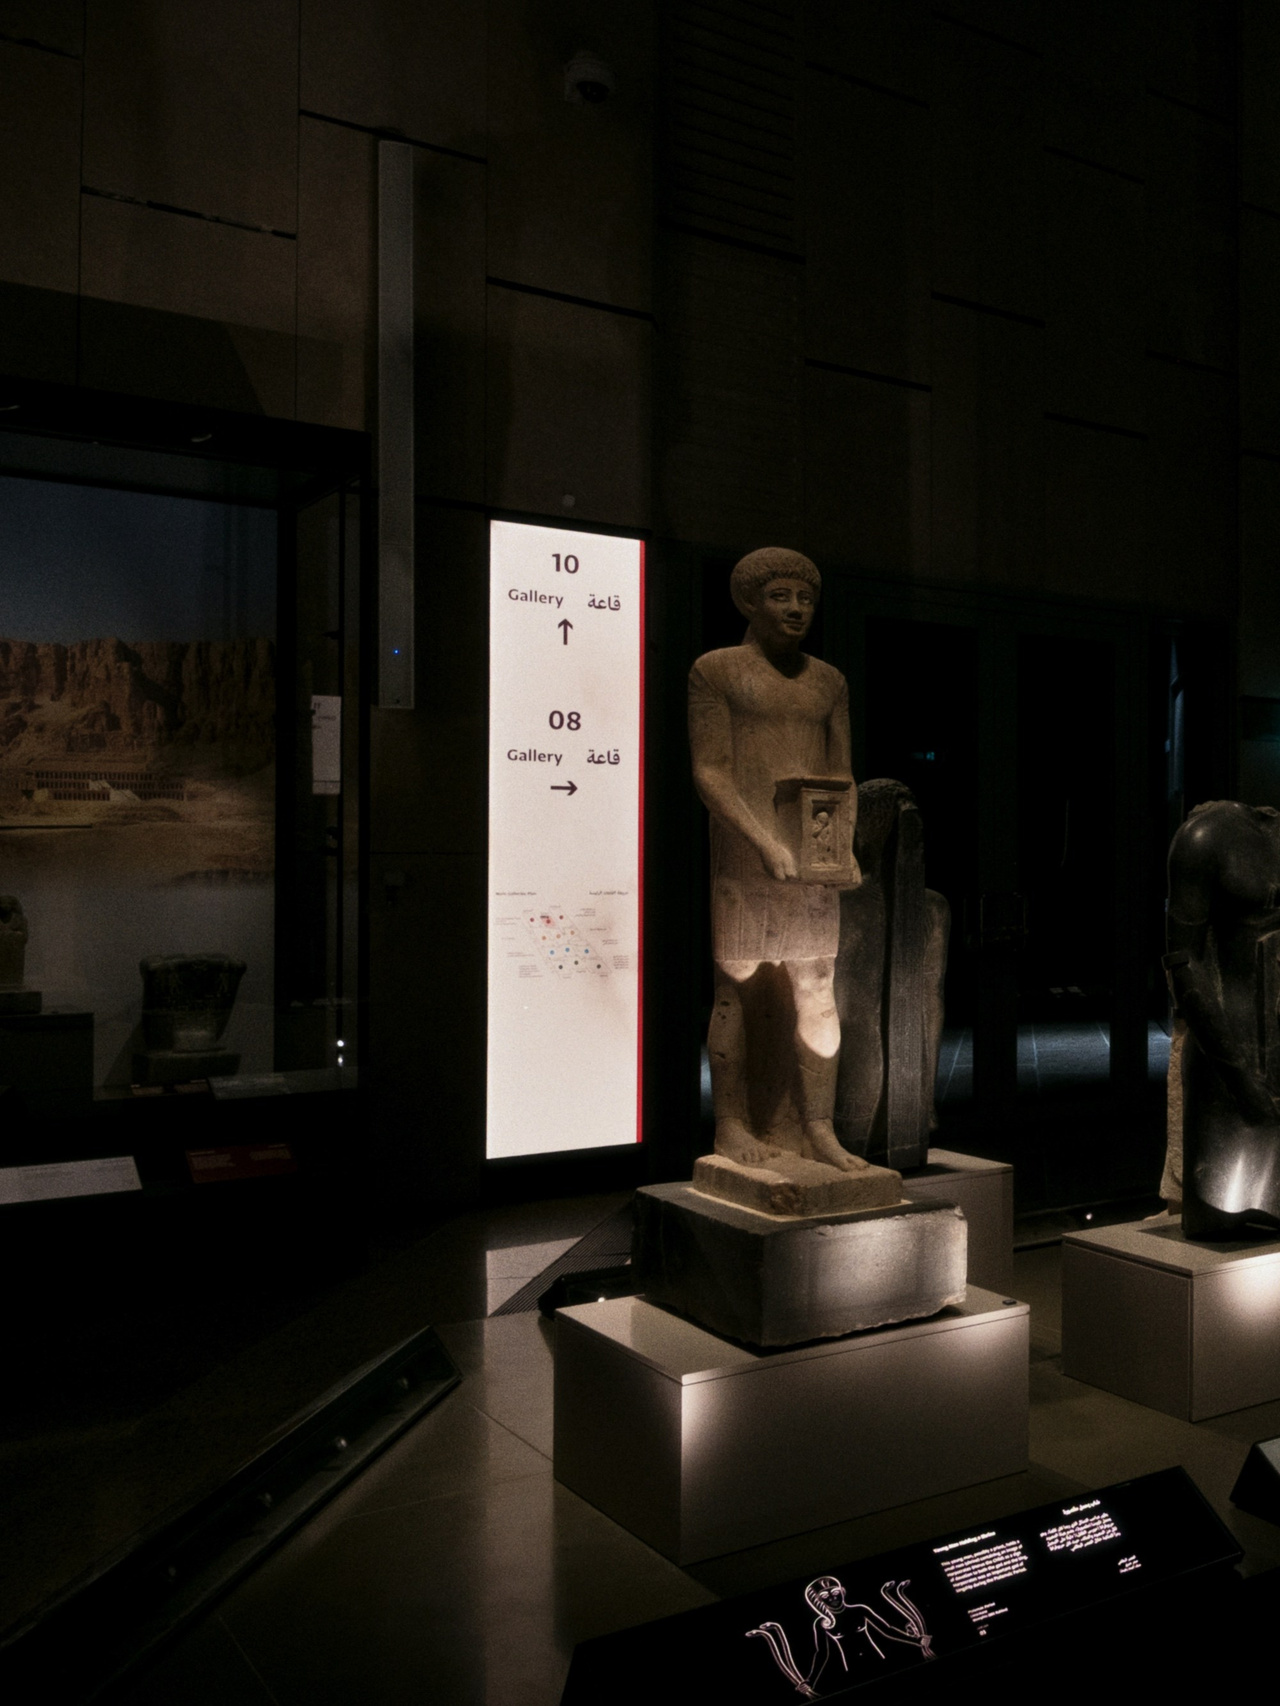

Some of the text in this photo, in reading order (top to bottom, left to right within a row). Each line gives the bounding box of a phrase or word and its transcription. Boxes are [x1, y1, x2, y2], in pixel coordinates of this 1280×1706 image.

[552, 553, 579, 574] 10
[508, 588, 564, 609] Gallery
[588, 593, 621, 611] قاعة
[549, 710, 581, 731] 08
[507, 749, 563, 767] Gallery
[587, 749, 620, 765] قاعة
